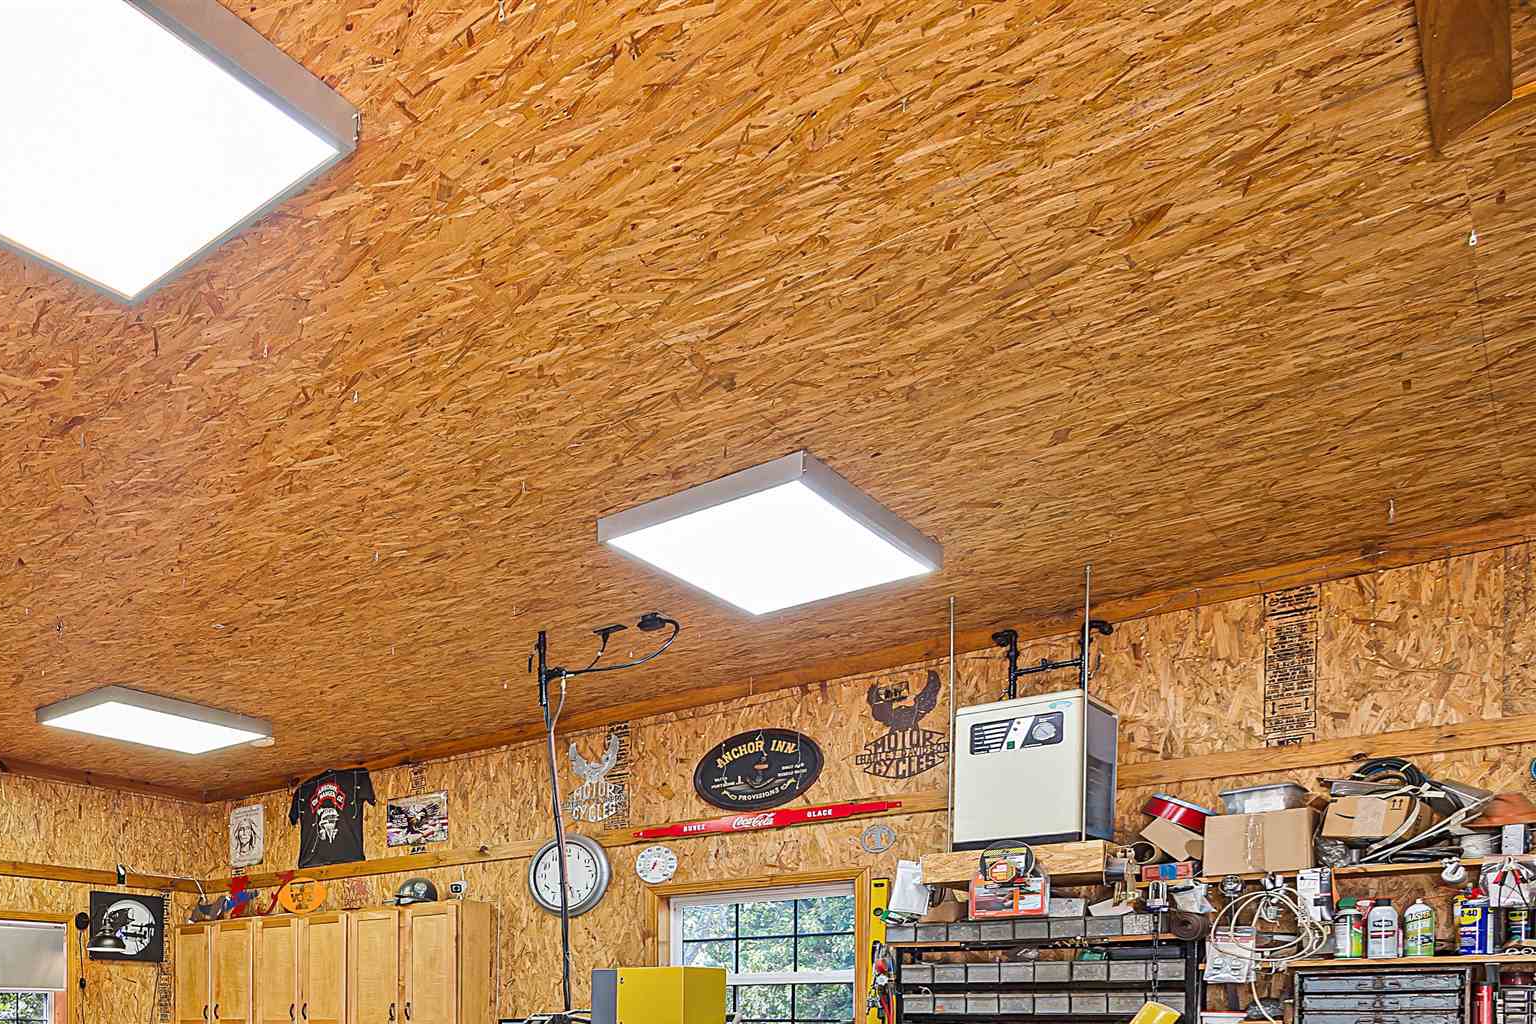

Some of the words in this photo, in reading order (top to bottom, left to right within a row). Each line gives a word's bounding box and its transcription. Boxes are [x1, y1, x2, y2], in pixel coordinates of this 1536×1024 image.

[716, 740, 764, 768] ANCHOR
[770, 740, 798, 753] INN
[738, 787, 780, 800] PROVISIONS
